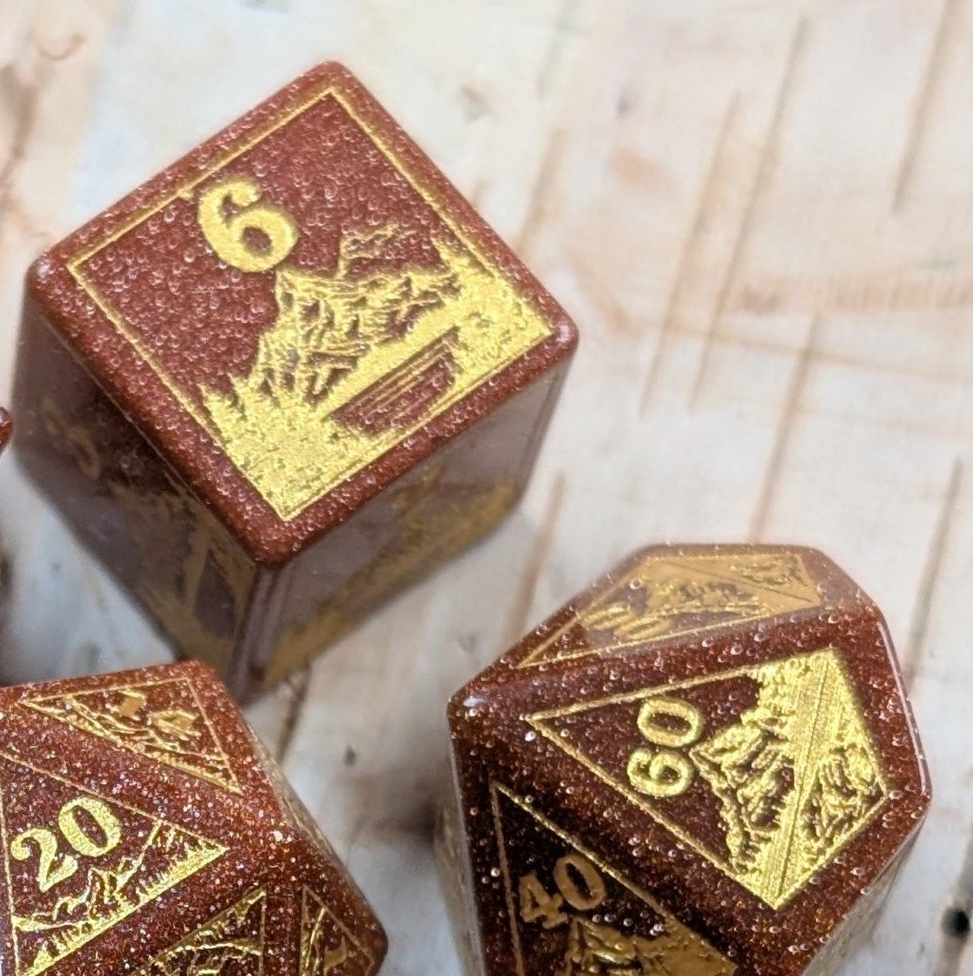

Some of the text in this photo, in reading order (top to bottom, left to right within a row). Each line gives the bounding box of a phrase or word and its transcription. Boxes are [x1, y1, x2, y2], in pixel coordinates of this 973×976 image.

[198, 177, 299, 273] 6
[109, 688, 202, 741] 14
[627, 699, 704, 798] 60
[10, 797, 121, 892] 20
[518, 853, 608, 925] 40
